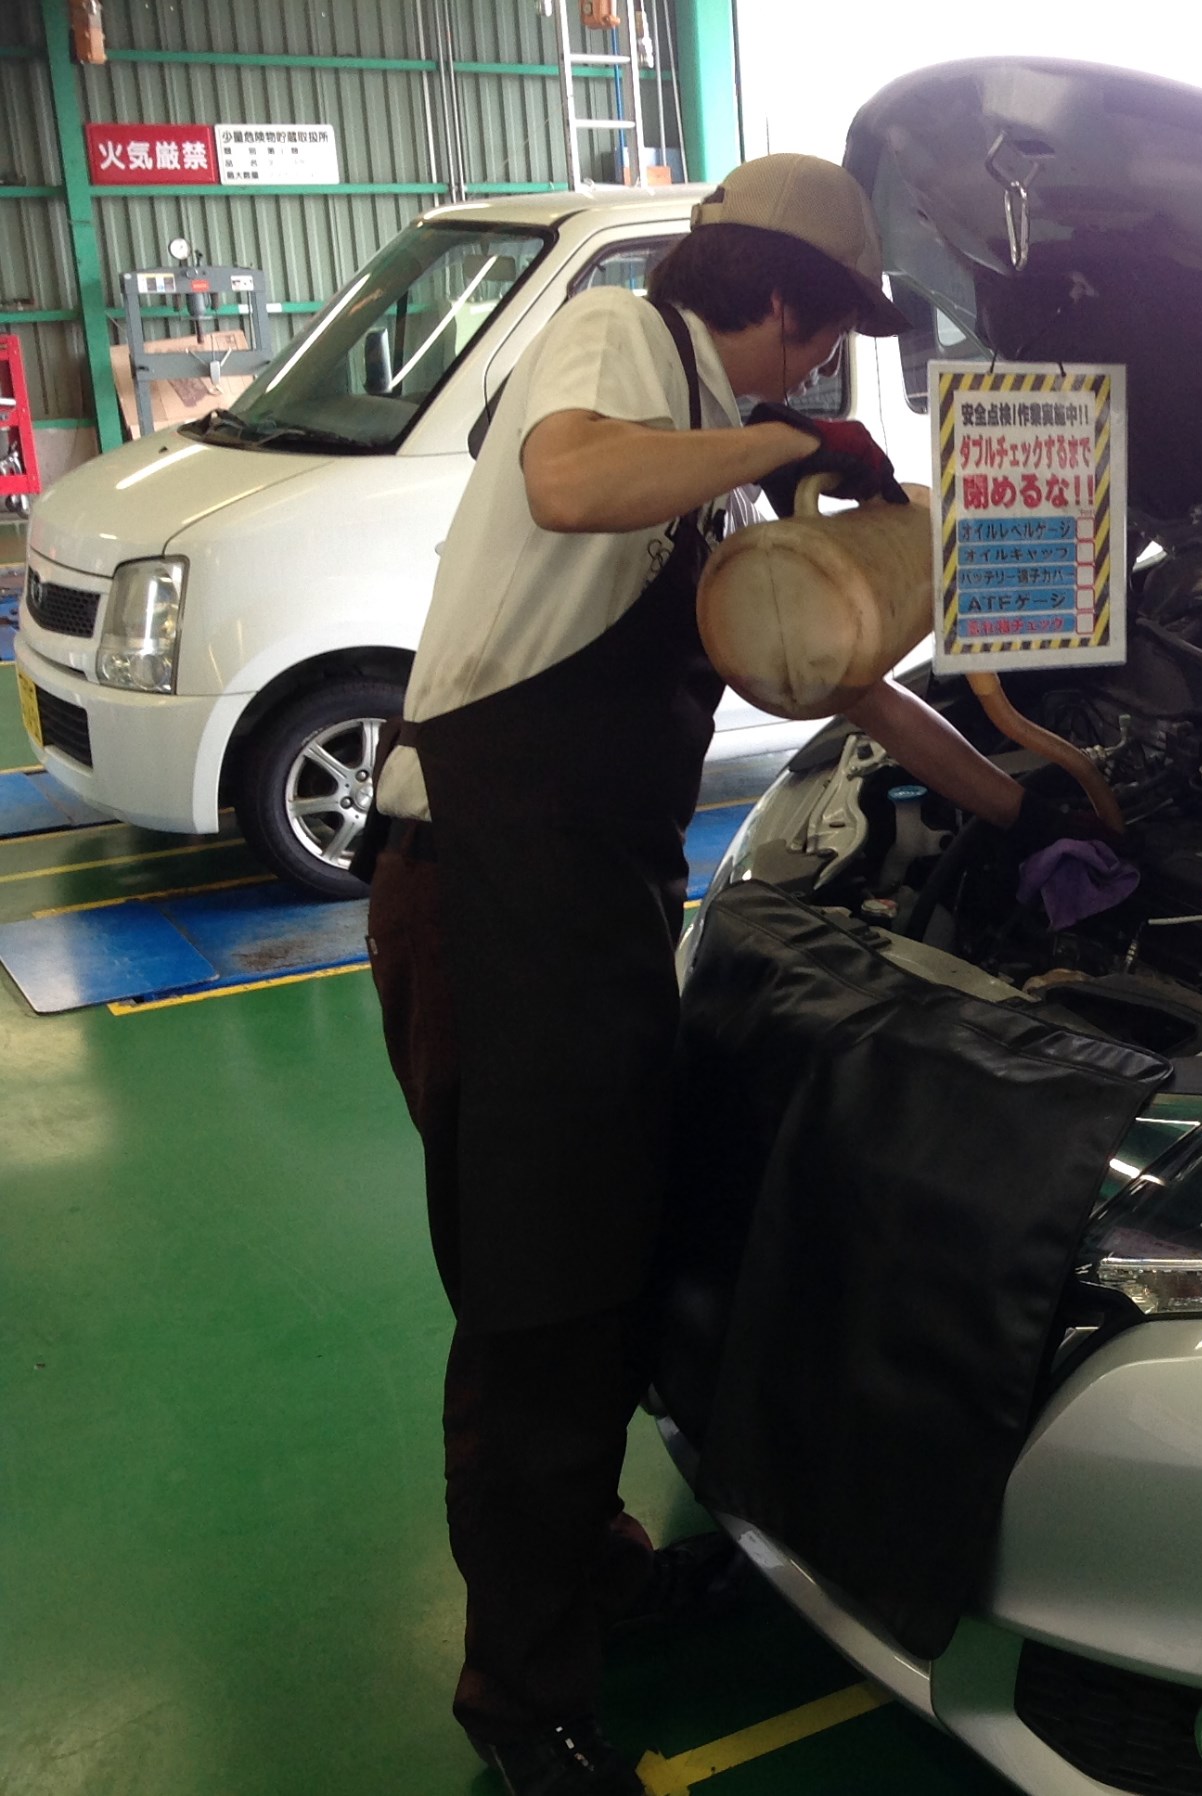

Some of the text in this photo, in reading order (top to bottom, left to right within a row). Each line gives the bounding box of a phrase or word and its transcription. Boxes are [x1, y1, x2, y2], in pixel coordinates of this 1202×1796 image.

[98, 141, 209, 171] 火気厳禁
[959, 435, 1092, 470] ダブルチェックするまで
[962, 473, 1094, 510] 閉めるな!!
[961, 520, 1071, 540] オイルレベルゲージ
[967, 592, 1067, 613] ATFゲージ
